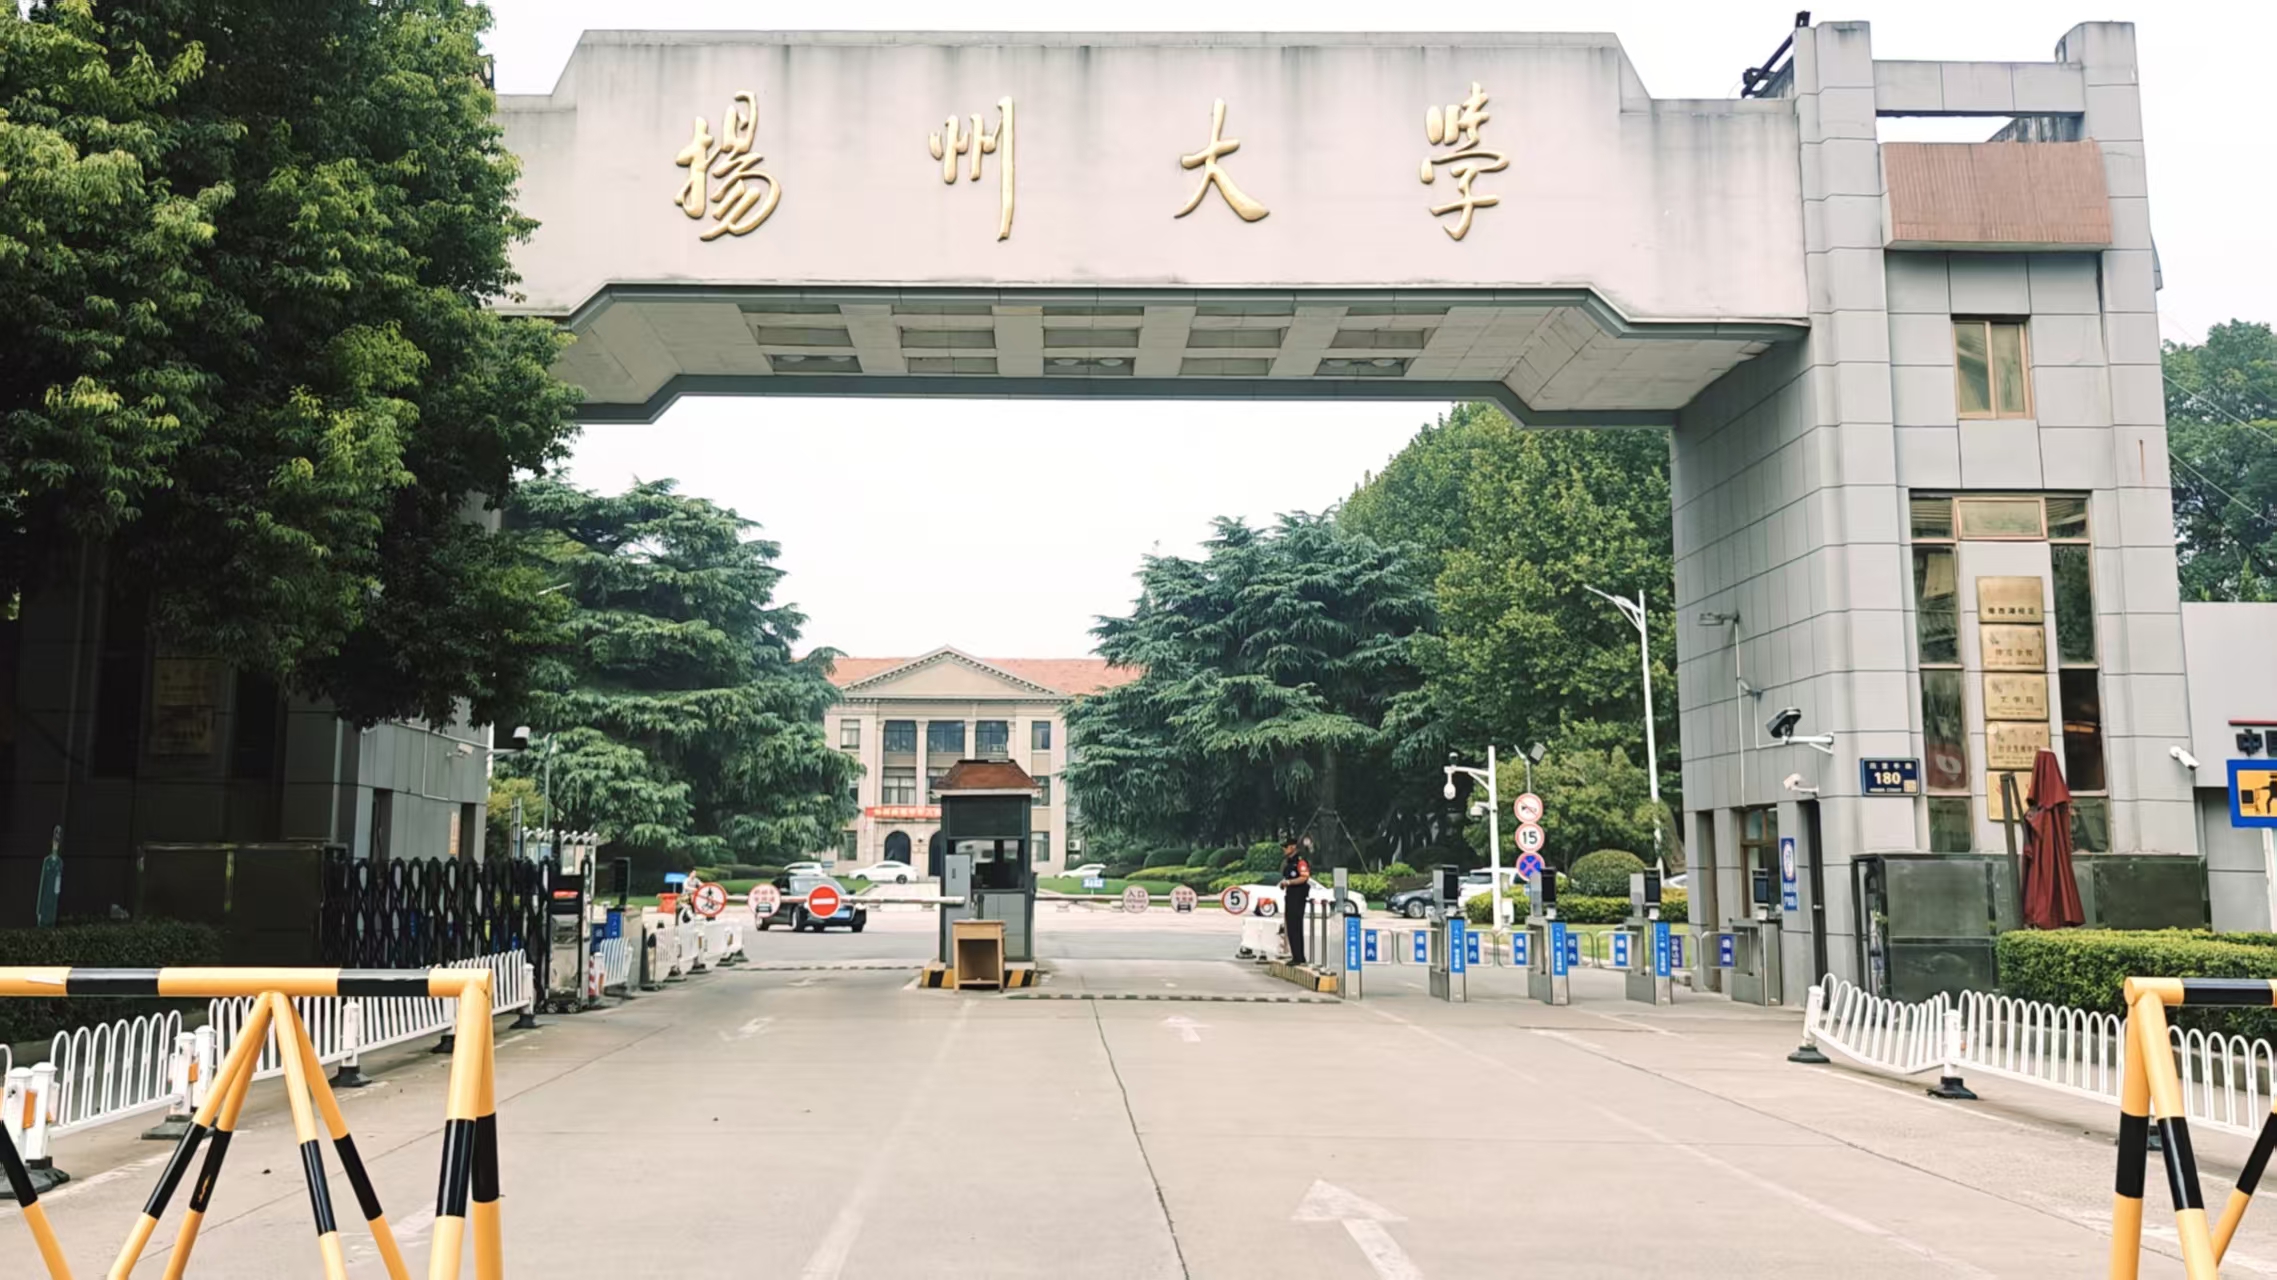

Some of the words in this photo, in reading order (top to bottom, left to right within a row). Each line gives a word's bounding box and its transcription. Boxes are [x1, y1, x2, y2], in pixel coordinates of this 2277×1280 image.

[1874, 771, 1902, 785] 180
[1522, 830, 1538, 845] 15
[1126, 889, 1146, 898] 入口
[1230, 890, 1241, 907] 5
